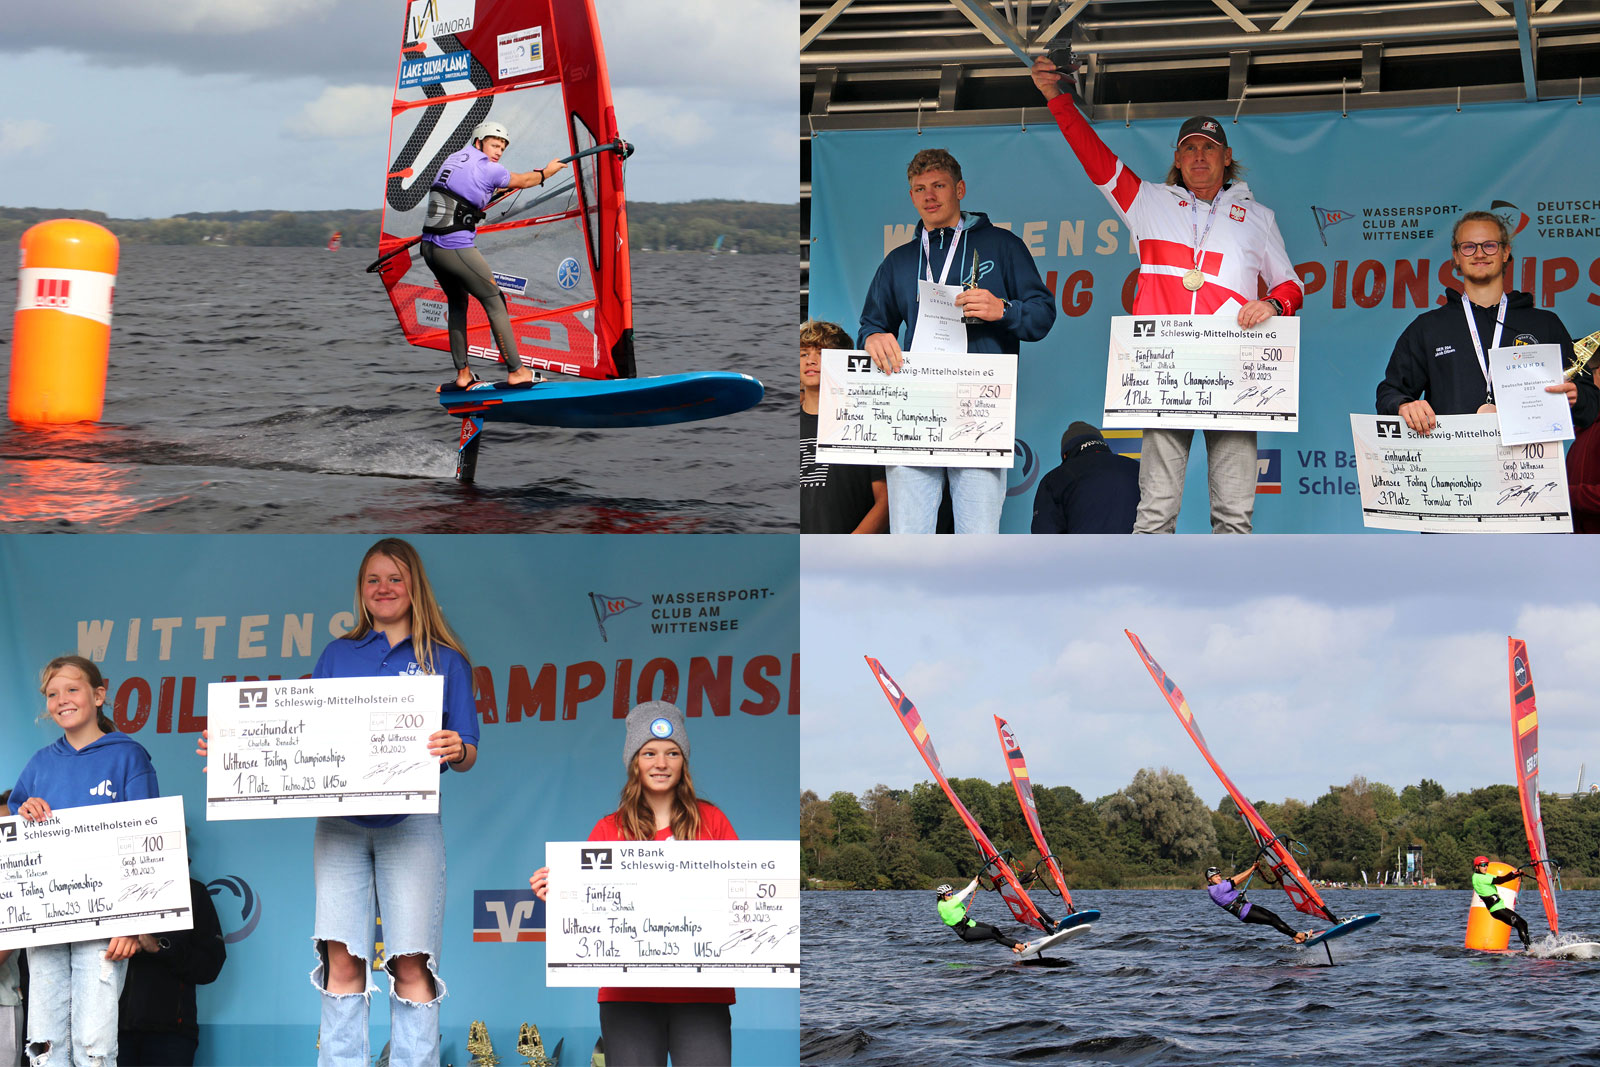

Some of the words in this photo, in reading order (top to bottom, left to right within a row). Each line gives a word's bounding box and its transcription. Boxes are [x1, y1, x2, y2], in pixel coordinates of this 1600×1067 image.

[432, 17, 471, 36] VANORA
[402, 63, 422, 79] LAKE
[1363, 205, 1462, 217] WASSERSPORT-
[1363, 219, 1396, 229] CLUB
[1401, 219, 1419, 228] AM
[1537, 214, 1596, 224] SEGLER-
[1363, 230, 1434, 240] WITTENSEE
[1161, 329, 1262, 339] Schleswig-Mittelholstein
[467, 345, 580, 376] SEERNE
[1261, 348, 1282, 361] 500
[1506, 362, 1545, 370] URKUNDE
[1121, 372, 1149, 387] Wittensee
[1155, 370, 1178, 389] Foiling
[1184, 371, 1234, 389] Championships
[979, 385, 1001, 398] 250
[1160, 390, 1192, 405] Formular
[1195, 391, 1212, 406] Foil
[836, 408, 864, 421] Wittensee
[897, 409, 947, 427] Championships
[891, 427, 921, 441] Formular
[926, 427, 943, 442] Foil
[1385, 451, 1422, 462] einhundert
[1522, 443, 1544, 459] 100
[1297, 450, 1327, 468] VR
[1335, 450, 1357, 468] Ba
[1431, 475, 1482, 491] Championships
[1504, 472, 1534, 480] 3.10.2023
[1299, 476, 1360, 494] Schle
[1421, 494, 1451, 506] Formular
[1454, 494, 1472, 506] Foil
[651, 588, 775, 605] WASSERSPORT-
[651, 607, 692, 620] CLUB
[698, 606, 720, 617] AM
[651, 619, 739, 634] WITTENSEE
[77, 611, 354, 662] WITTENS
[275, 687, 287, 696] VR
[291, 686, 314, 695] Bank
[275, 694, 398, 708] Schleswig-Mittelholstein
[401, 695, 415, 703] eG
[242, 720, 306, 737] zweihundert
[394, 713, 424, 729] 200
[388, 733, 417, 742] Wittensee
[372, 744, 406, 754] 3.10.2023
[223, 752, 258, 771] Wittensee
[261, 750, 288, 771] Foiling
[294, 748, 345, 767] Championships
[247, 775, 270, 793] Platz
[23, 820, 35, 829] VR
[24, 819, 142, 840] Schleswig-Mittelholstein
[145, 817, 158, 826] eG
[142, 835, 163, 852] 100
[620, 849, 635, 857] VR
[638, 848, 664, 857] Bank
[0, 853, 43, 870] inhundert
[620, 860, 757, 872] Schleswig-Mittelholstein
[761, 861, 775, 870] eG
[124, 866, 155, 878] 3.10.2023
[17, 881, 45, 899] Foiling
[49, 874, 103, 895] Championships
[756, 883, 776, 898] 50
[585, 886, 621, 905] fünfzig
[732, 901, 749, 912] Groß
[755, 901, 783, 911] Wittensee
[7, 906, 32, 924] Platz
[732, 913, 771, 923] 3.10.2023
[562, 917, 601, 934] Wittensee
[607, 917, 637, 939] Foiling
[643, 915, 702, 937] Championships
[594, 939, 621, 957] Platz
